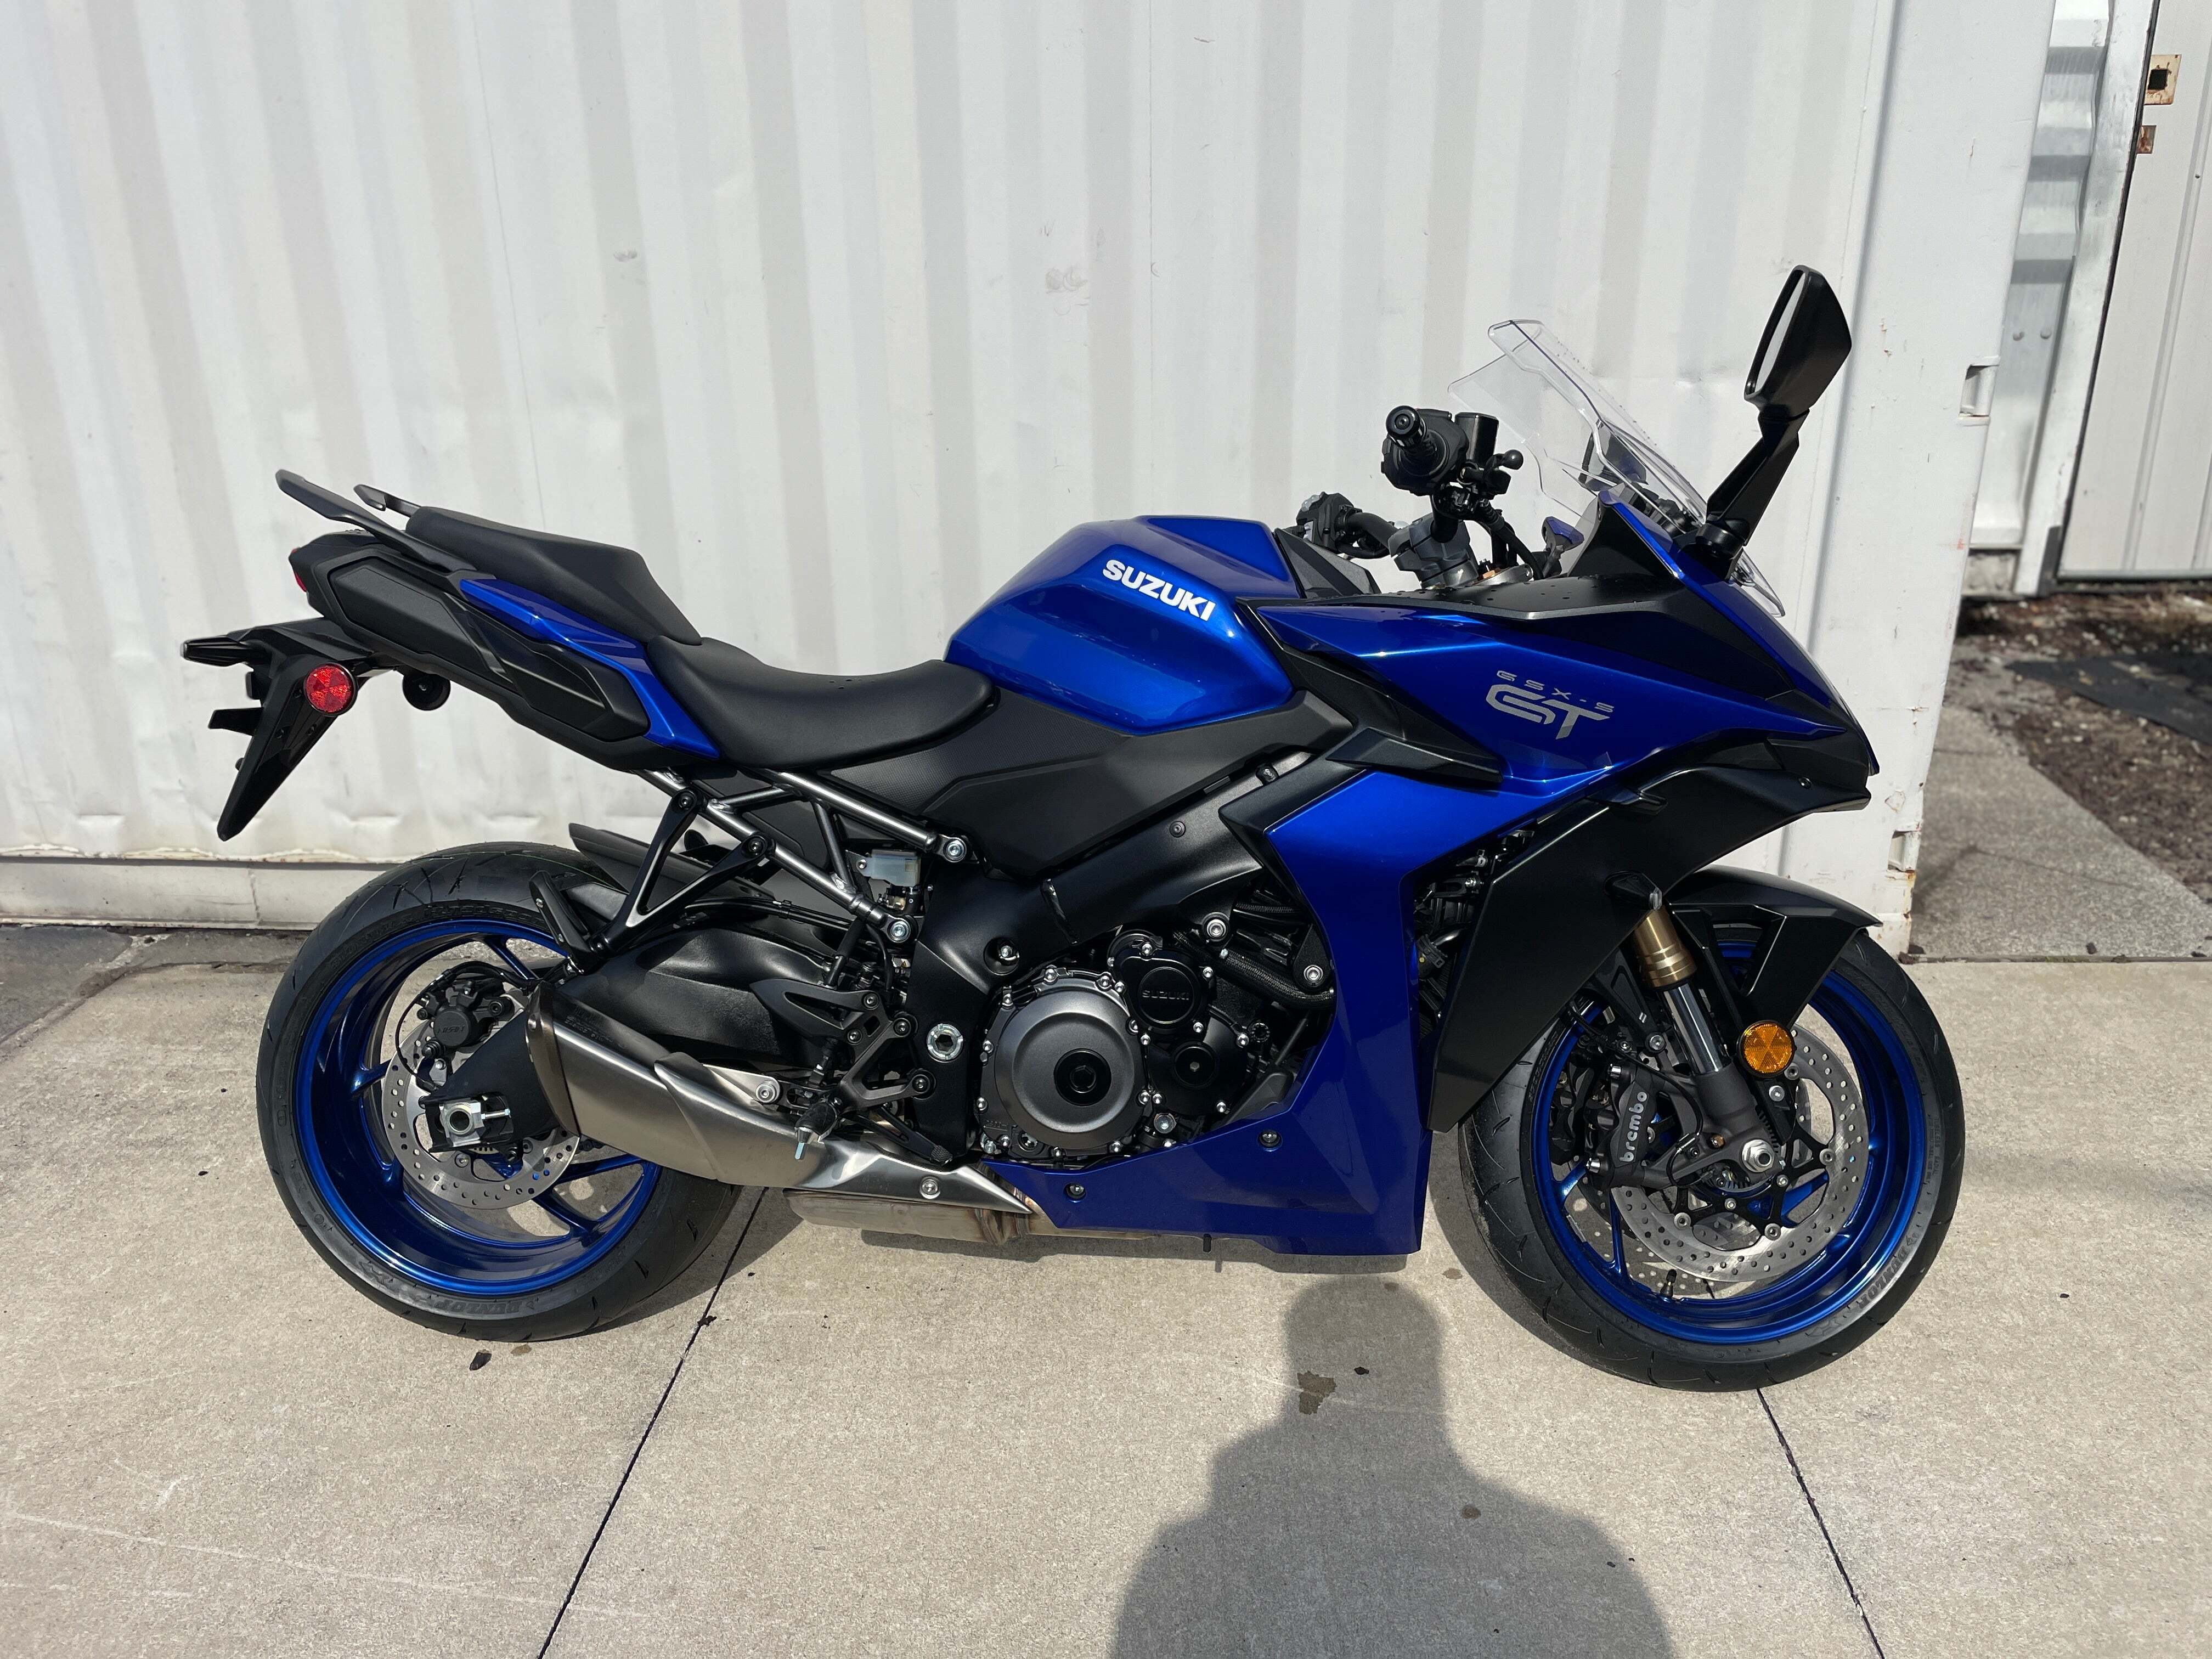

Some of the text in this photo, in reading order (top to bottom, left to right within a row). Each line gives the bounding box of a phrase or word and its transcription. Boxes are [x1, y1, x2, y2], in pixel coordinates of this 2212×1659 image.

[1103, 560, 1216, 621] SUZUKI
[1486, 684, 1610, 740] GT
[1142, 989, 1189, 1000] SUZUKI
[1620, 1092, 1647, 1162] brembo
